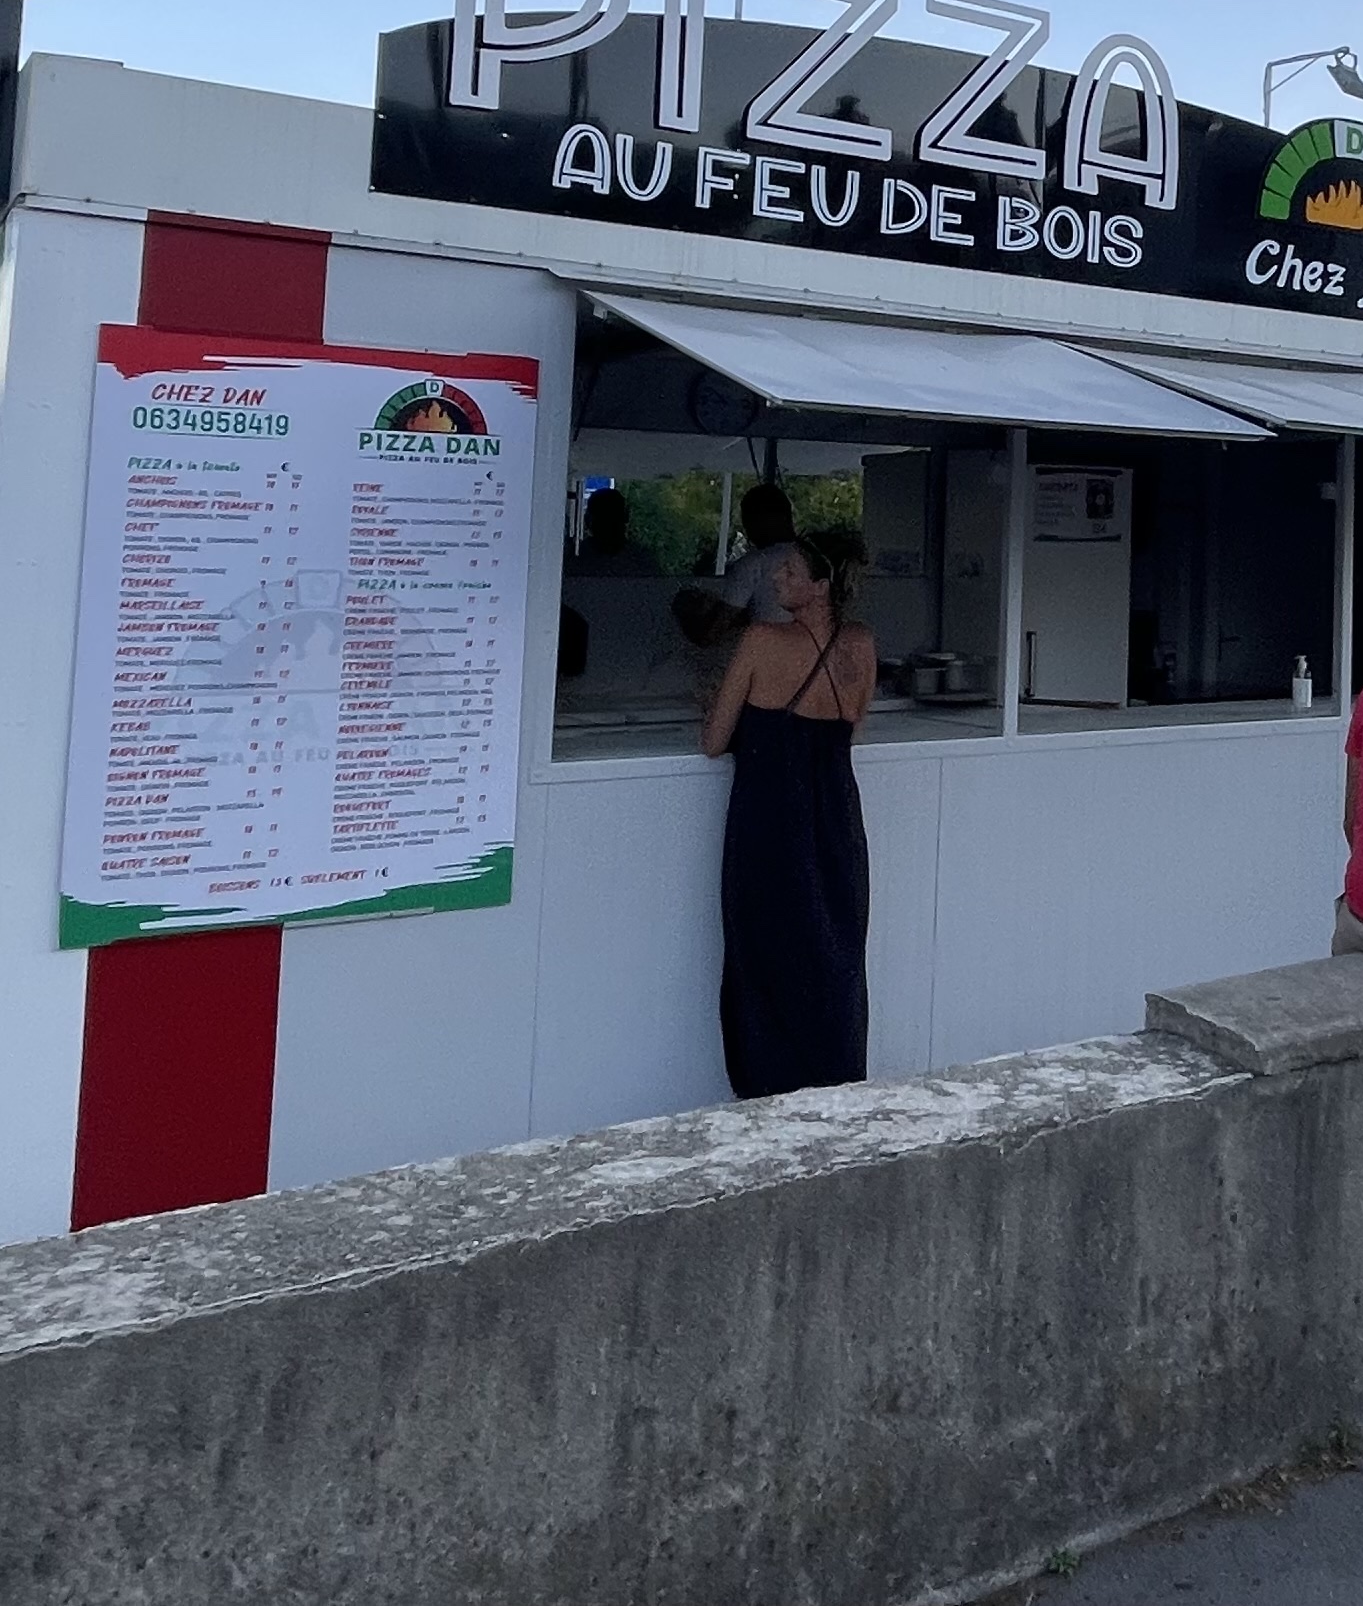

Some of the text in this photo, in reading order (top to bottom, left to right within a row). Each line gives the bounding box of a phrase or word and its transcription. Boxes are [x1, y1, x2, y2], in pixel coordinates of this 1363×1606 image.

[553, 123, 1146, 268] AU FEU DE BOIS
[1243, 236, 1347, 300] Chez
[151, 383, 266, 406] CHEZ DAN
[430, 381, 440, 393] D
[133, 407, 289, 436] 0634958419
[359, 432, 501, 456] PIZZA DAN
[128, 457, 172, 470] PIZZA
[358, 580, 397, 590] PIZZA
